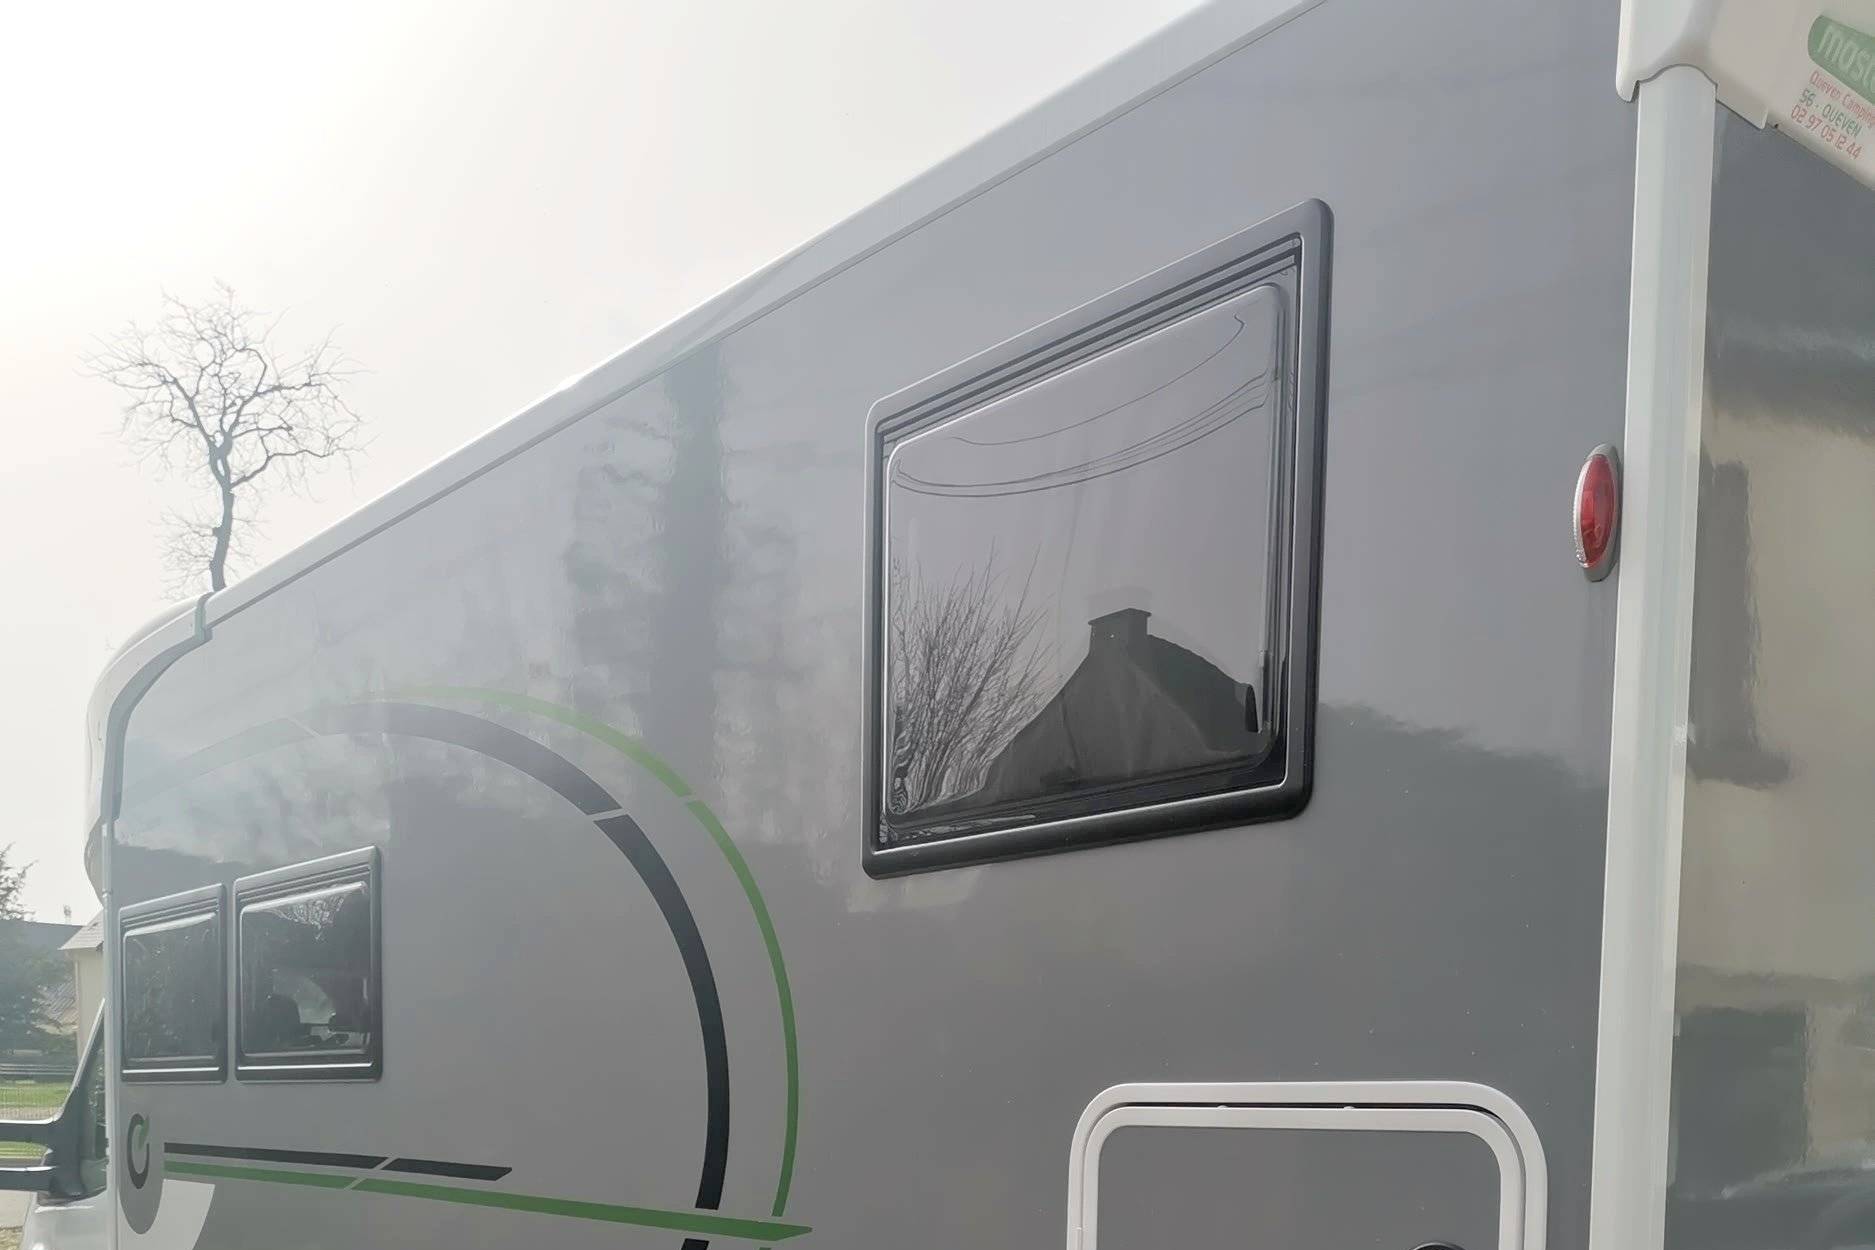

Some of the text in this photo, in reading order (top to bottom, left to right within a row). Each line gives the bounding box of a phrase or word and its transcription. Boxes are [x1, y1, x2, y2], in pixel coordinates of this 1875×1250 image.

[1791, 104, 1807, 123] 02
[1807, 114, 1823, 131] 97
[1799, 88, 1816, 106] 56
[1823, 104, 1862, 137] QUEVEN
